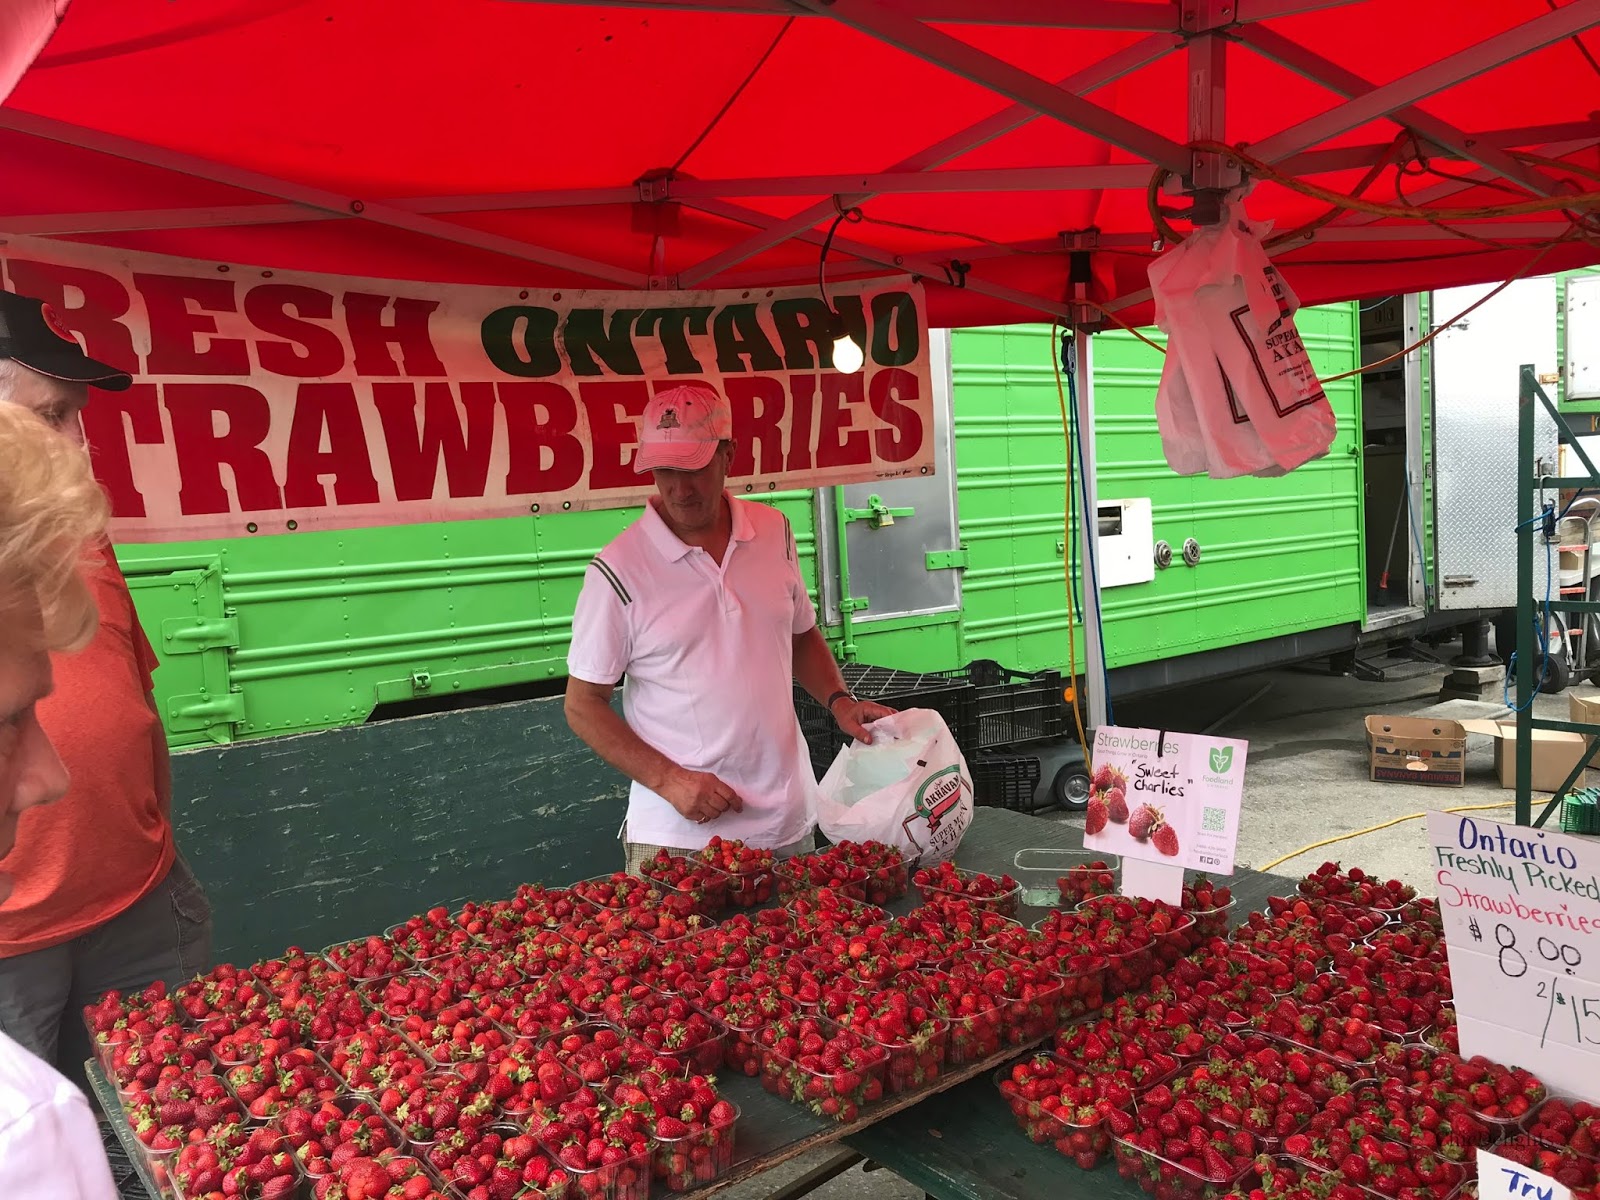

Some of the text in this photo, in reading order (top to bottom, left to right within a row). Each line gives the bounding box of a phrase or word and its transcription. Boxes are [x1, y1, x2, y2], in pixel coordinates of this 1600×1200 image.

[0, 258, 448, 378] RESH
[80, 367, 923, 518] TRAWBERIES
[1097, 732, 1179, 754] Strawberres
[925, 775, 960, 807] AKHAVAN
[1202, 775, 1234, 785] Foodland
[930, 823, 954, 848] SUPER
[1459, 817, 1577, 869] Ontario
[1435, 846, 1600, 902] Freshly Picked
